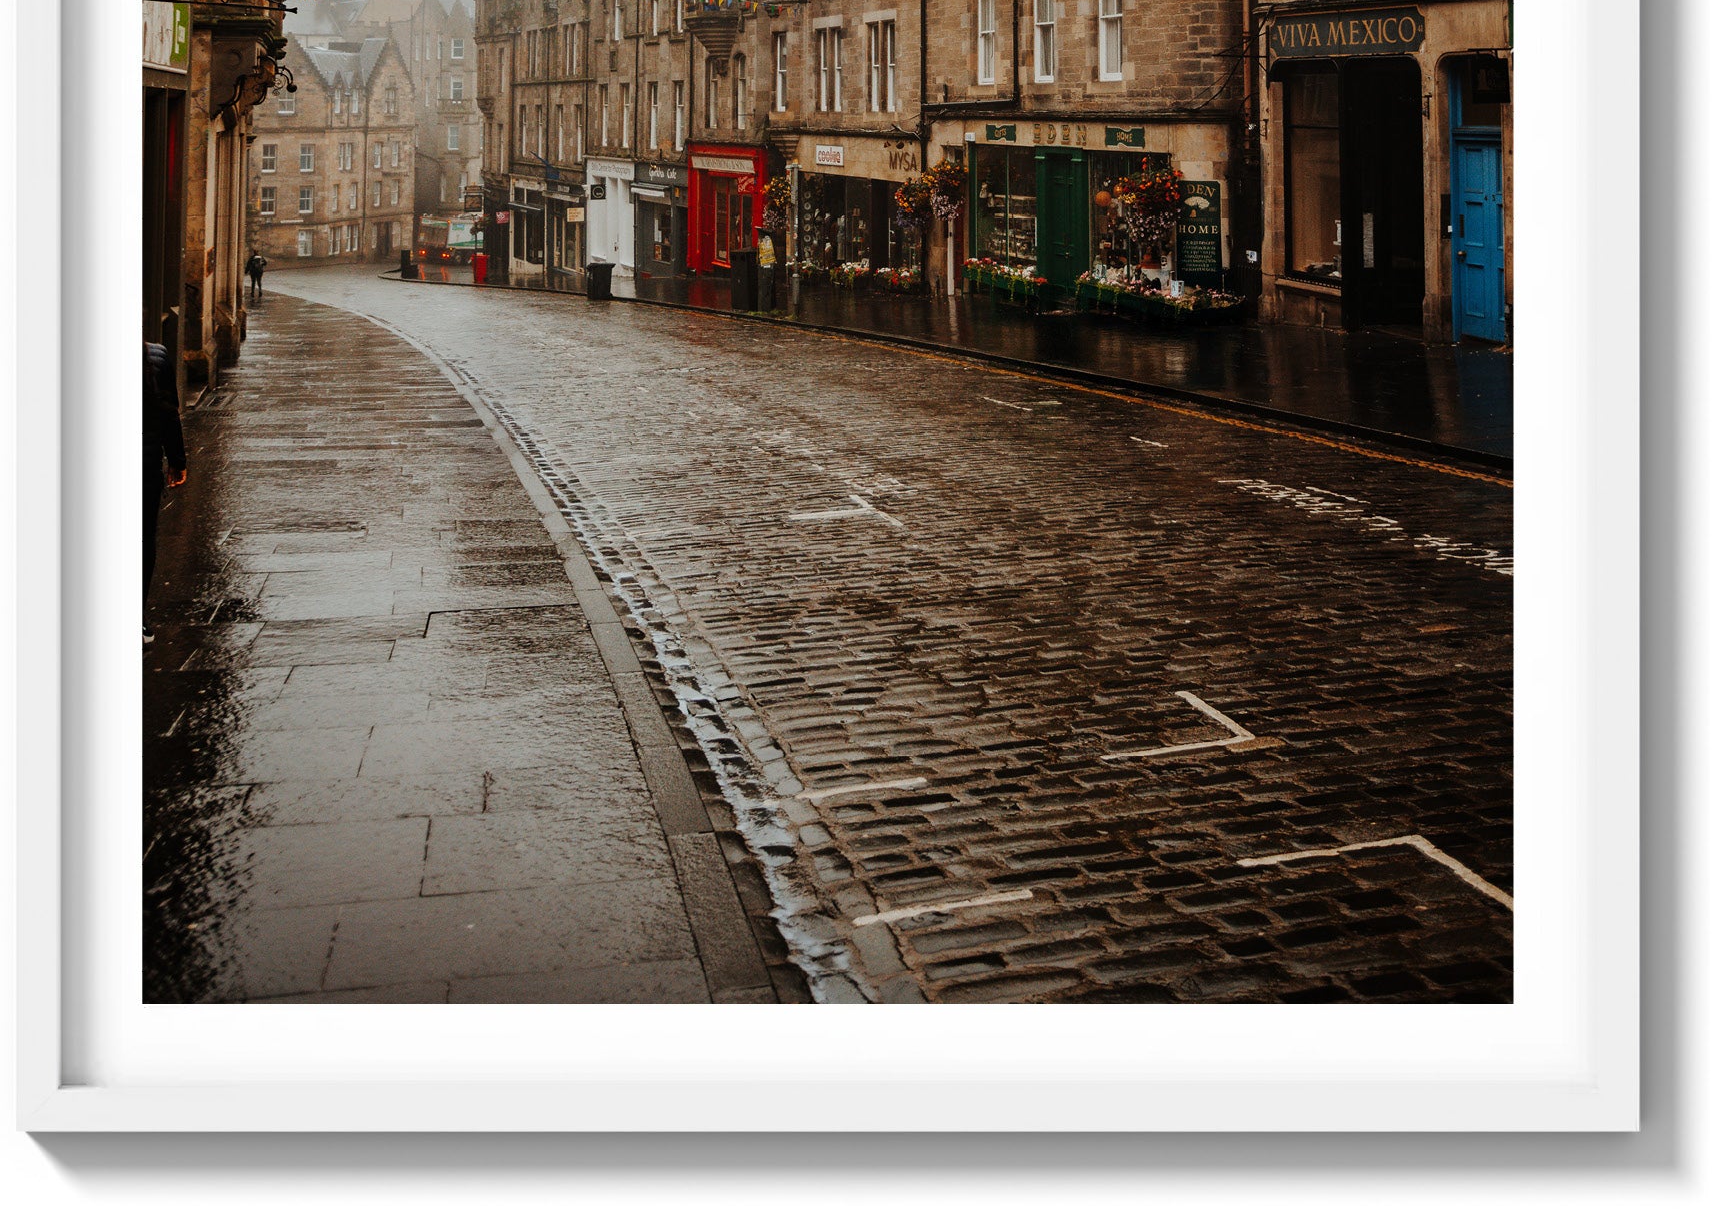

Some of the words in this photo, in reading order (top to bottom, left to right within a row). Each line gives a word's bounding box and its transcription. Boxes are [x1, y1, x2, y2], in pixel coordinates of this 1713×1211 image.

[1277, 22, 1321, 48] VIVA
[1326, 16, 1417, 46] MEXICO
[1033, 123, 1087, 145] EDEN
[1116, 131, 1133, 143] HOME
[889, 150, 918, 171] MYSA
[1179, 224, 1219, 235] HOME
